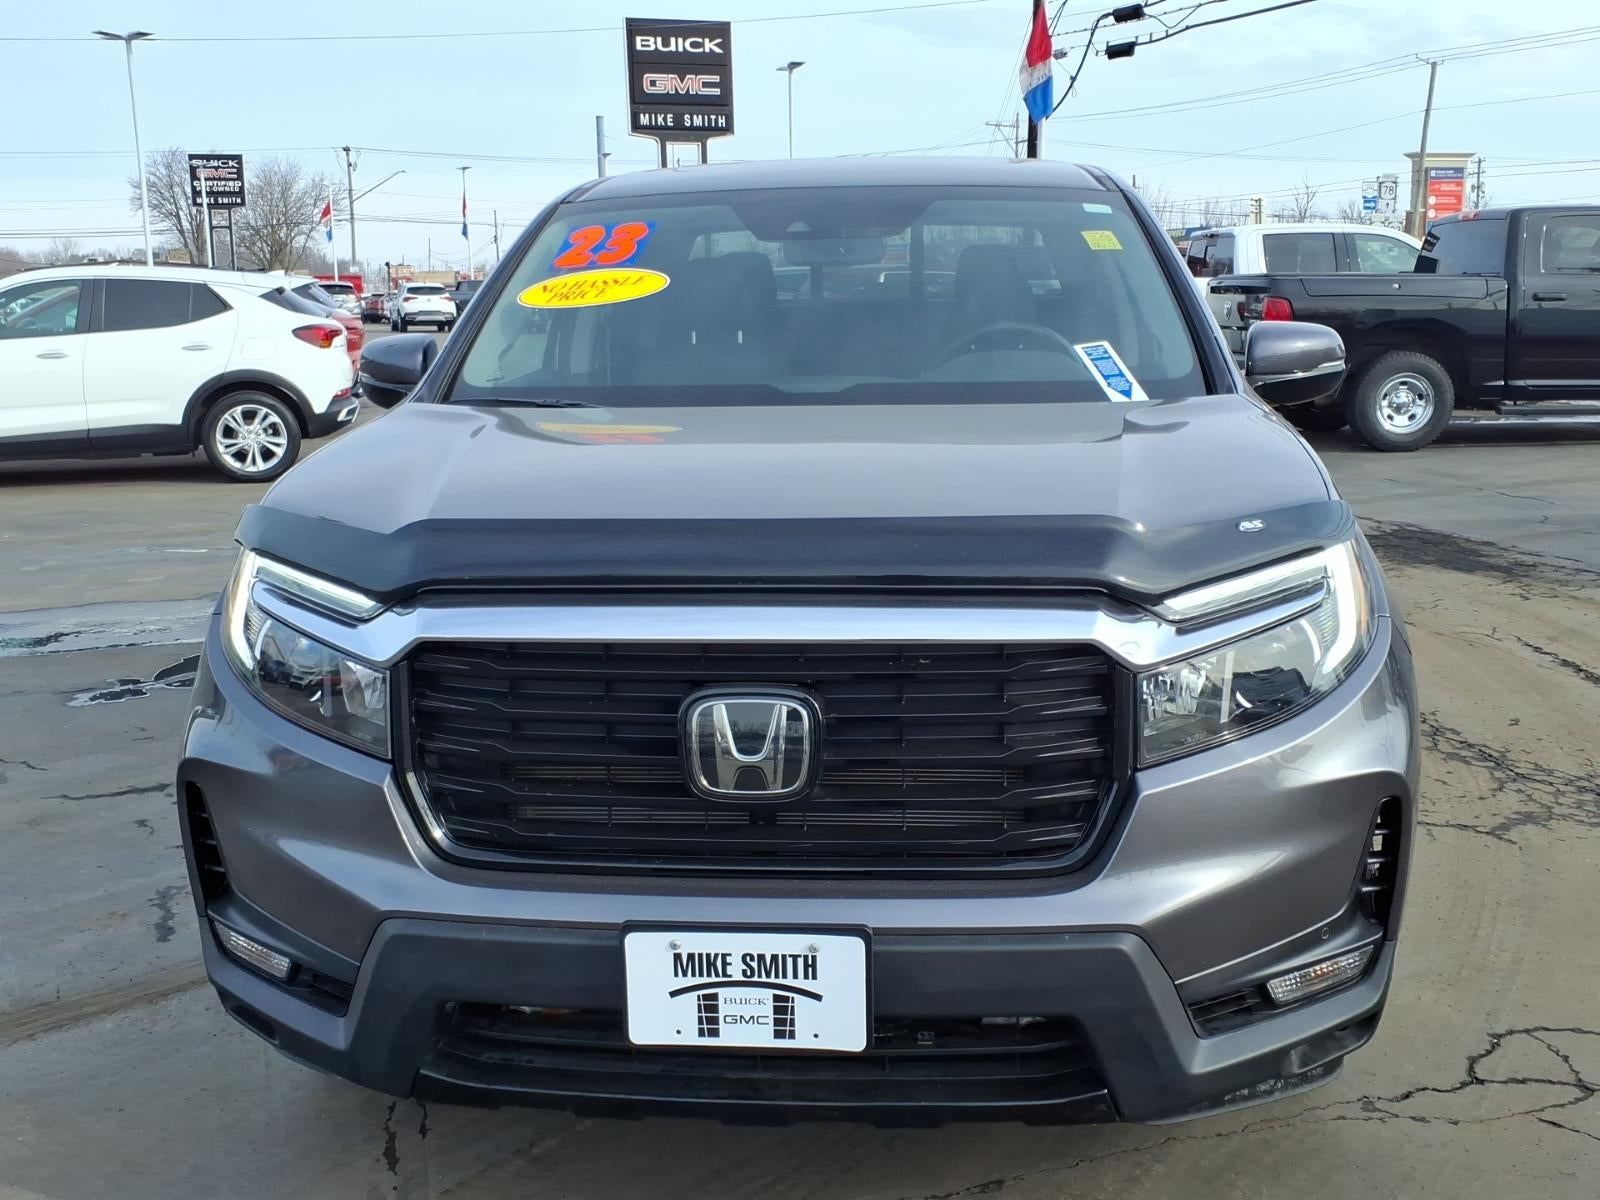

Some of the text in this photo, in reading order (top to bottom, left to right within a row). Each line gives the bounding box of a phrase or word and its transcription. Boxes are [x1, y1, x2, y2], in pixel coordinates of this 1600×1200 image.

[635, 35, 724, 54] BUICK
[643, 73, 720, 95] GMC
[640, 113, 726, 127] MIKE SMITH
[1382, 185, 1394, 196] 78
[553, 222, 649, 268] 23
[673, 952, 818, 981] MIKE SMITH
[723, 1014, 770, 1026] GMC
